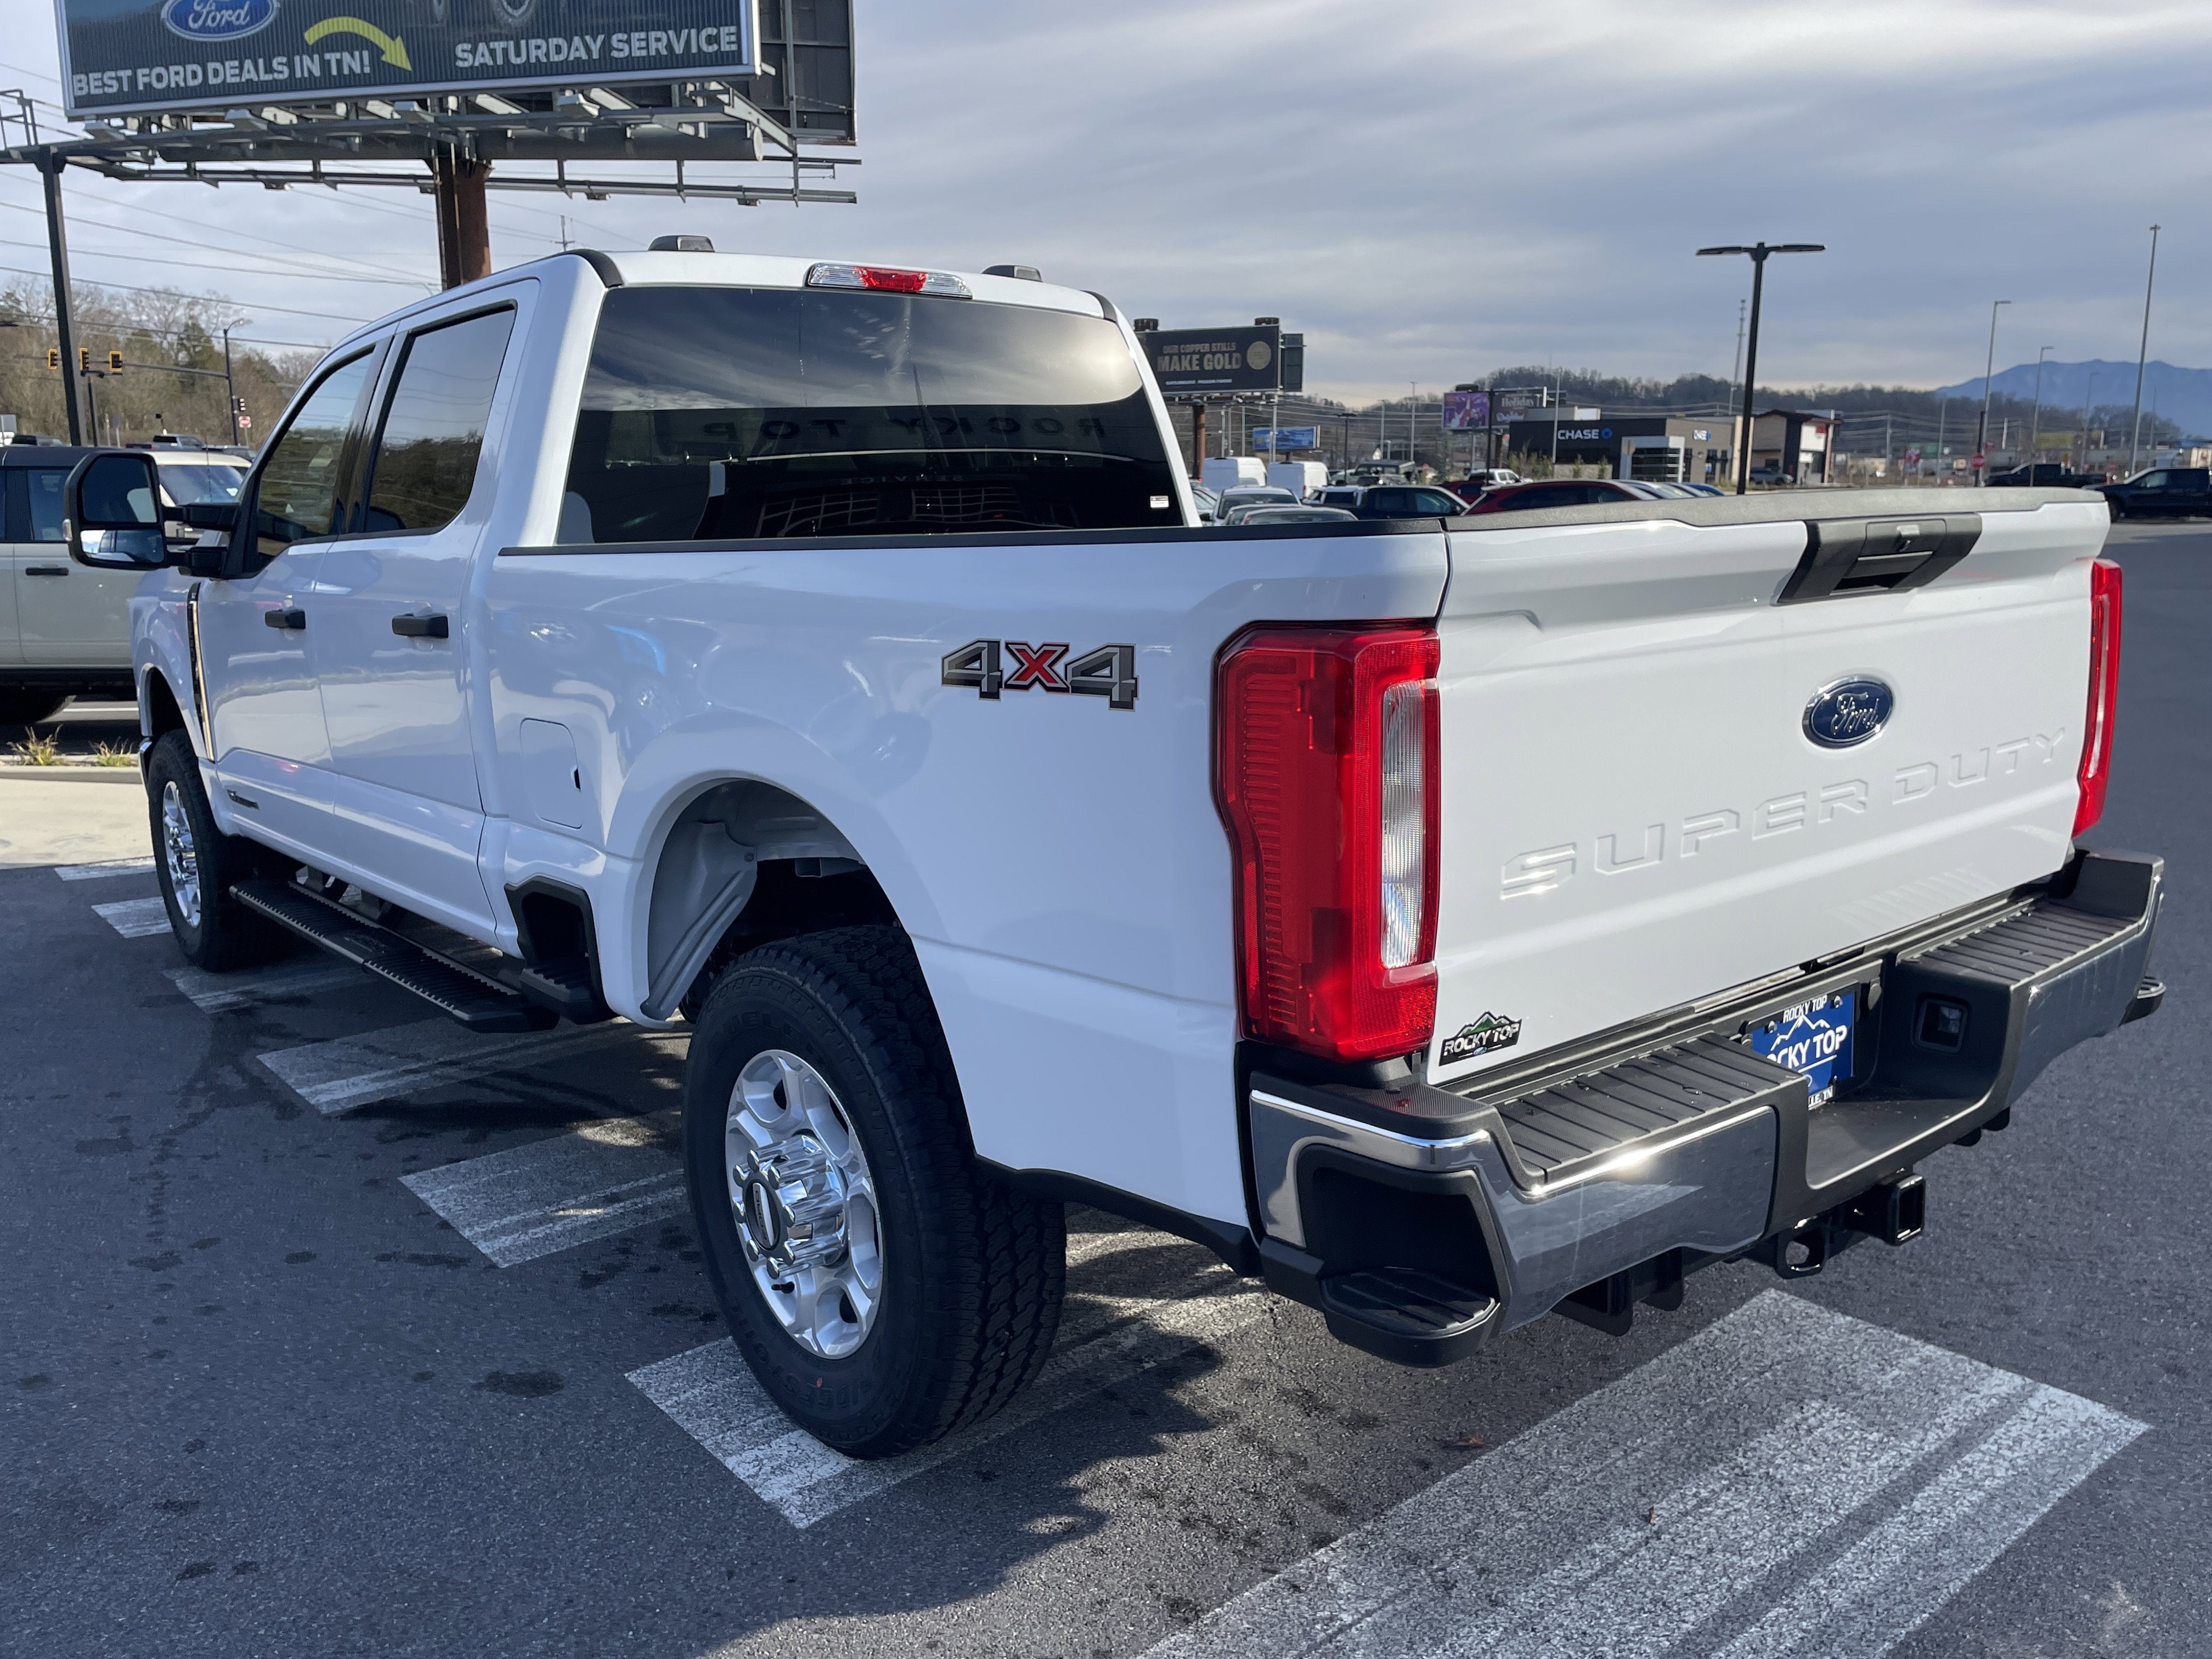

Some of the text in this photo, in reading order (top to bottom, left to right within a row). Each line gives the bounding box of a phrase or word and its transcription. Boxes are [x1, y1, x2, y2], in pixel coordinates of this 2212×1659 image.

[188, 0, 250, 29] Ford
[455, 26, 738, 68] SATURDAY SERVICE
[72, 50, 370, 96] BEST FORD DEALS IN TN!
[1157, 354, 1200, 372] MAKE
[1203, 353, 1242, 370] GOLD
[1180, 343, 1210, 353] COPPER
[1211, 342, 1236, 352] STILLS
[1558, 429, 1600, 440] CHASE
[1830, 691, 1880, 736] Ford
[1500, 726, 2066, 900] SUPER DUTY
[1783, 995, 1828, 1024] ROCKY TOP
[1443, 1023, 1520, 1057] ROCKY TOP
[1813, 1025, 1848, 1058] TOP
